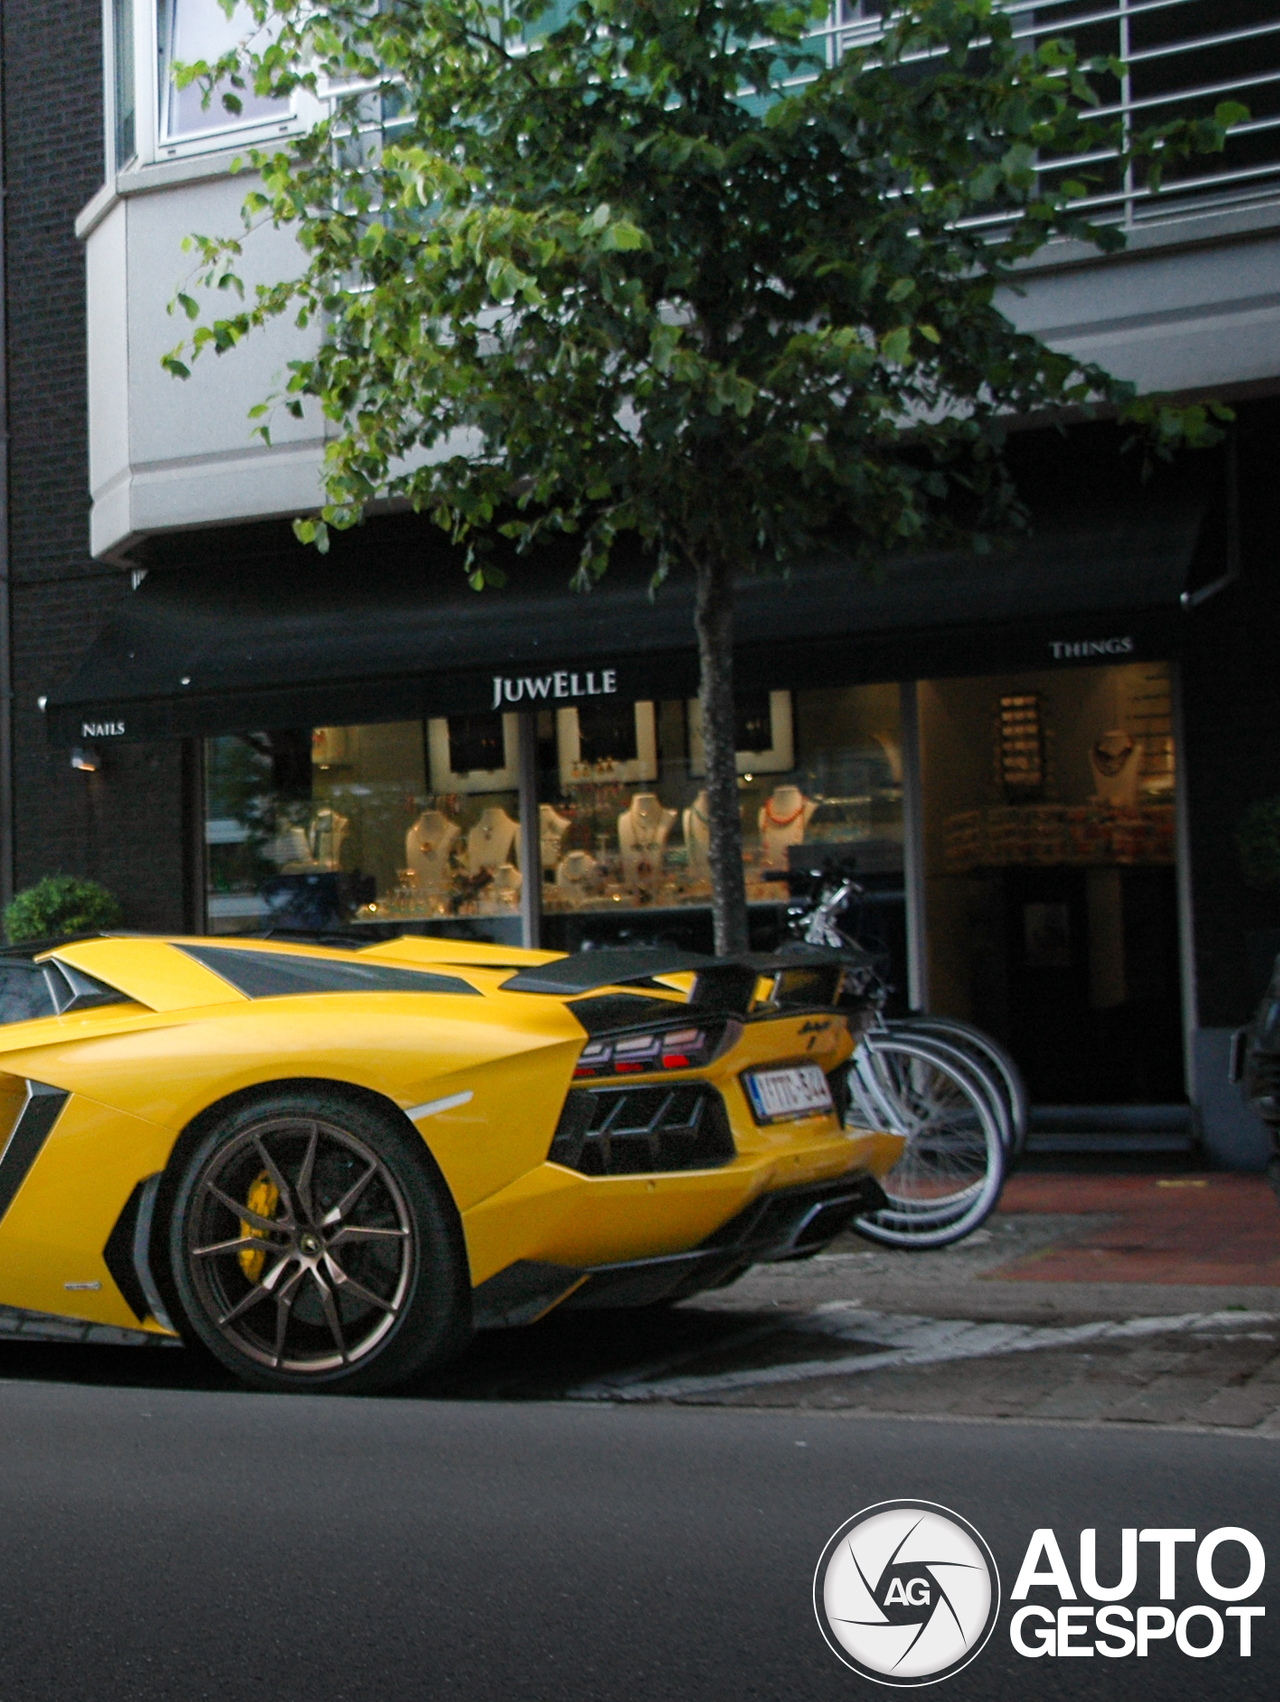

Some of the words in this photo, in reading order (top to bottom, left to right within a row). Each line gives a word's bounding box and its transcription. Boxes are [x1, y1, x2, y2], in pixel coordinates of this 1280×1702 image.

[1049, 636, 1134, 659] THINGS
[492, 671, 617, 710] JUWELLE
[82, 722, 126, 737] NAILS
